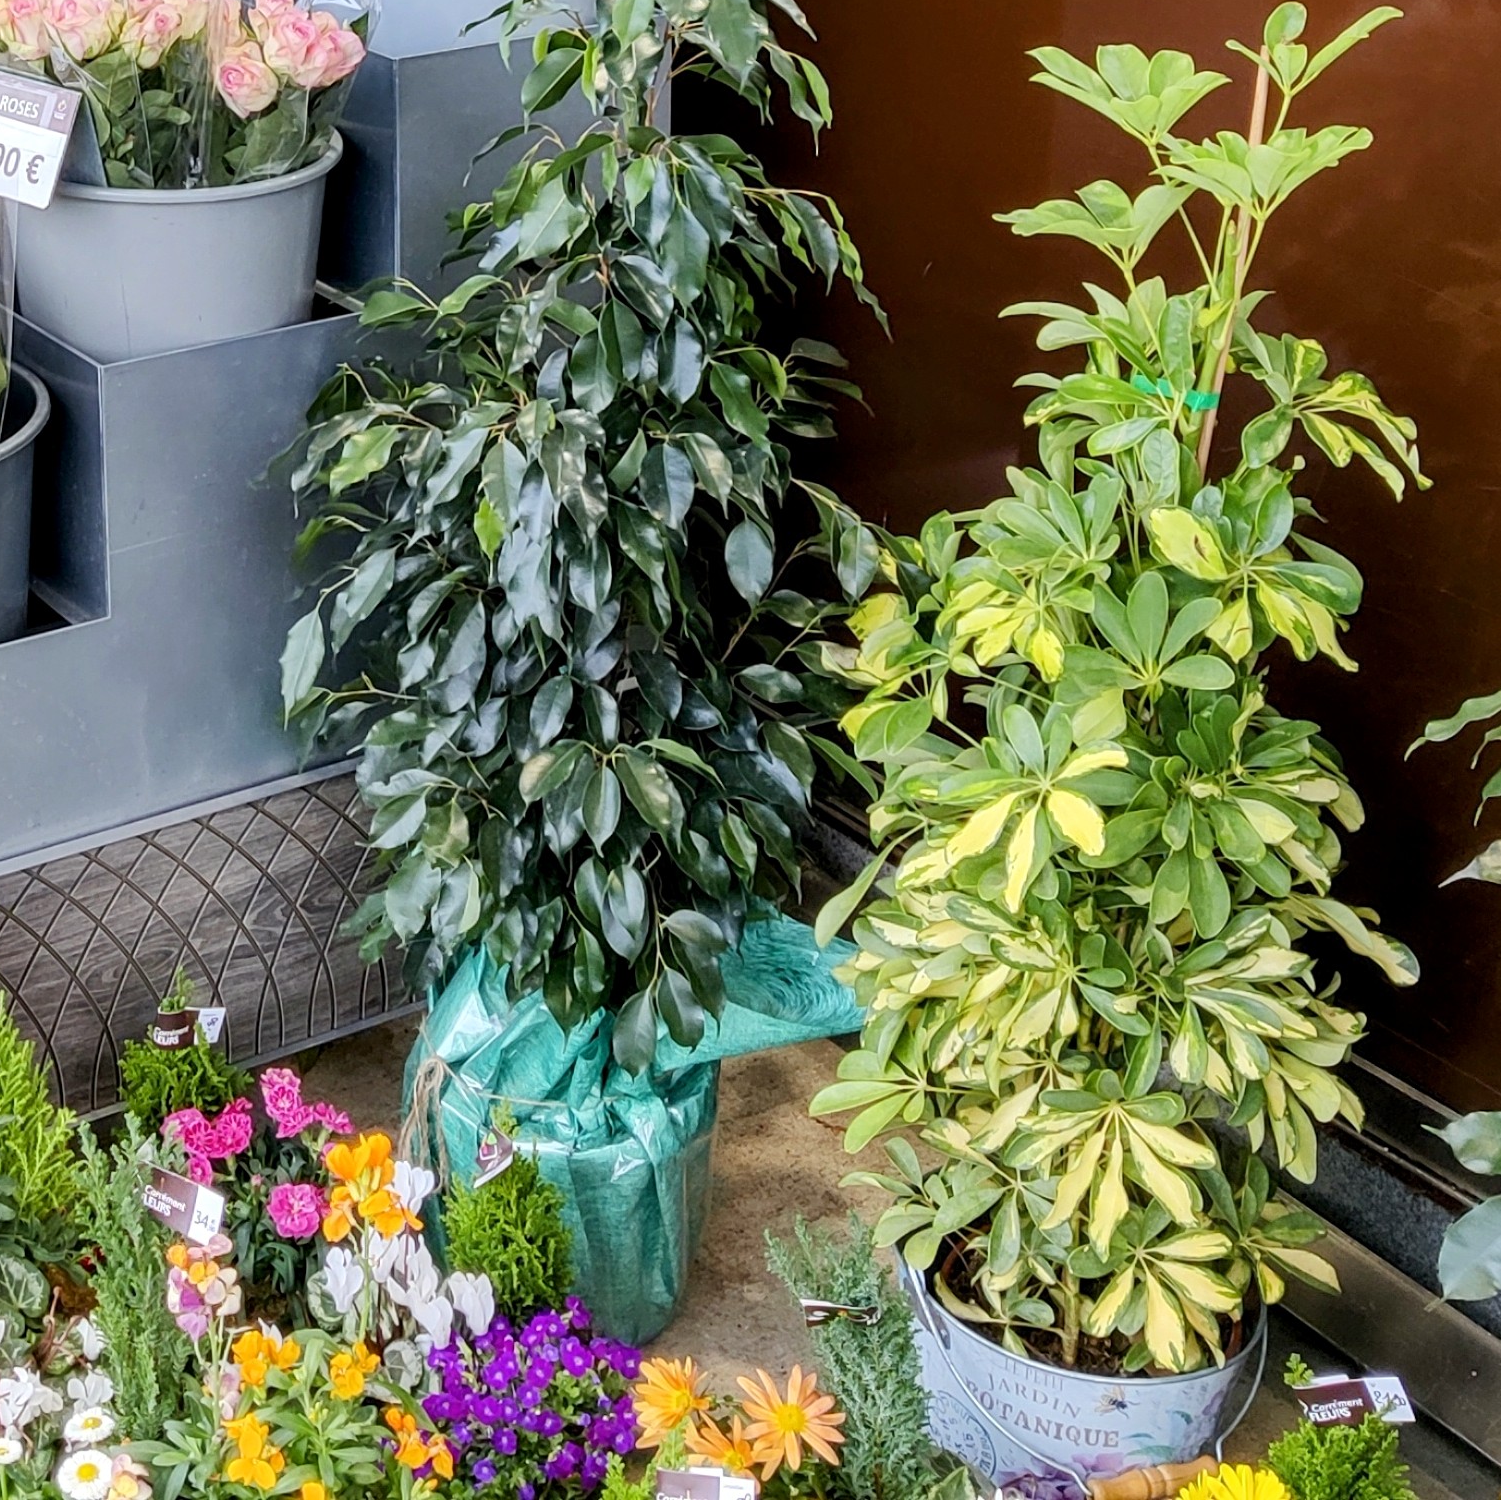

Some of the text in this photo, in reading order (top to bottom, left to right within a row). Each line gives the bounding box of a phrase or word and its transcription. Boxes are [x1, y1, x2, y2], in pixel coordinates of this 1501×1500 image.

[0, 94, 40, 120] ROSES
[26, 154, 45, 185] €
[988, 1373, 1081, 1419] JARDIN
